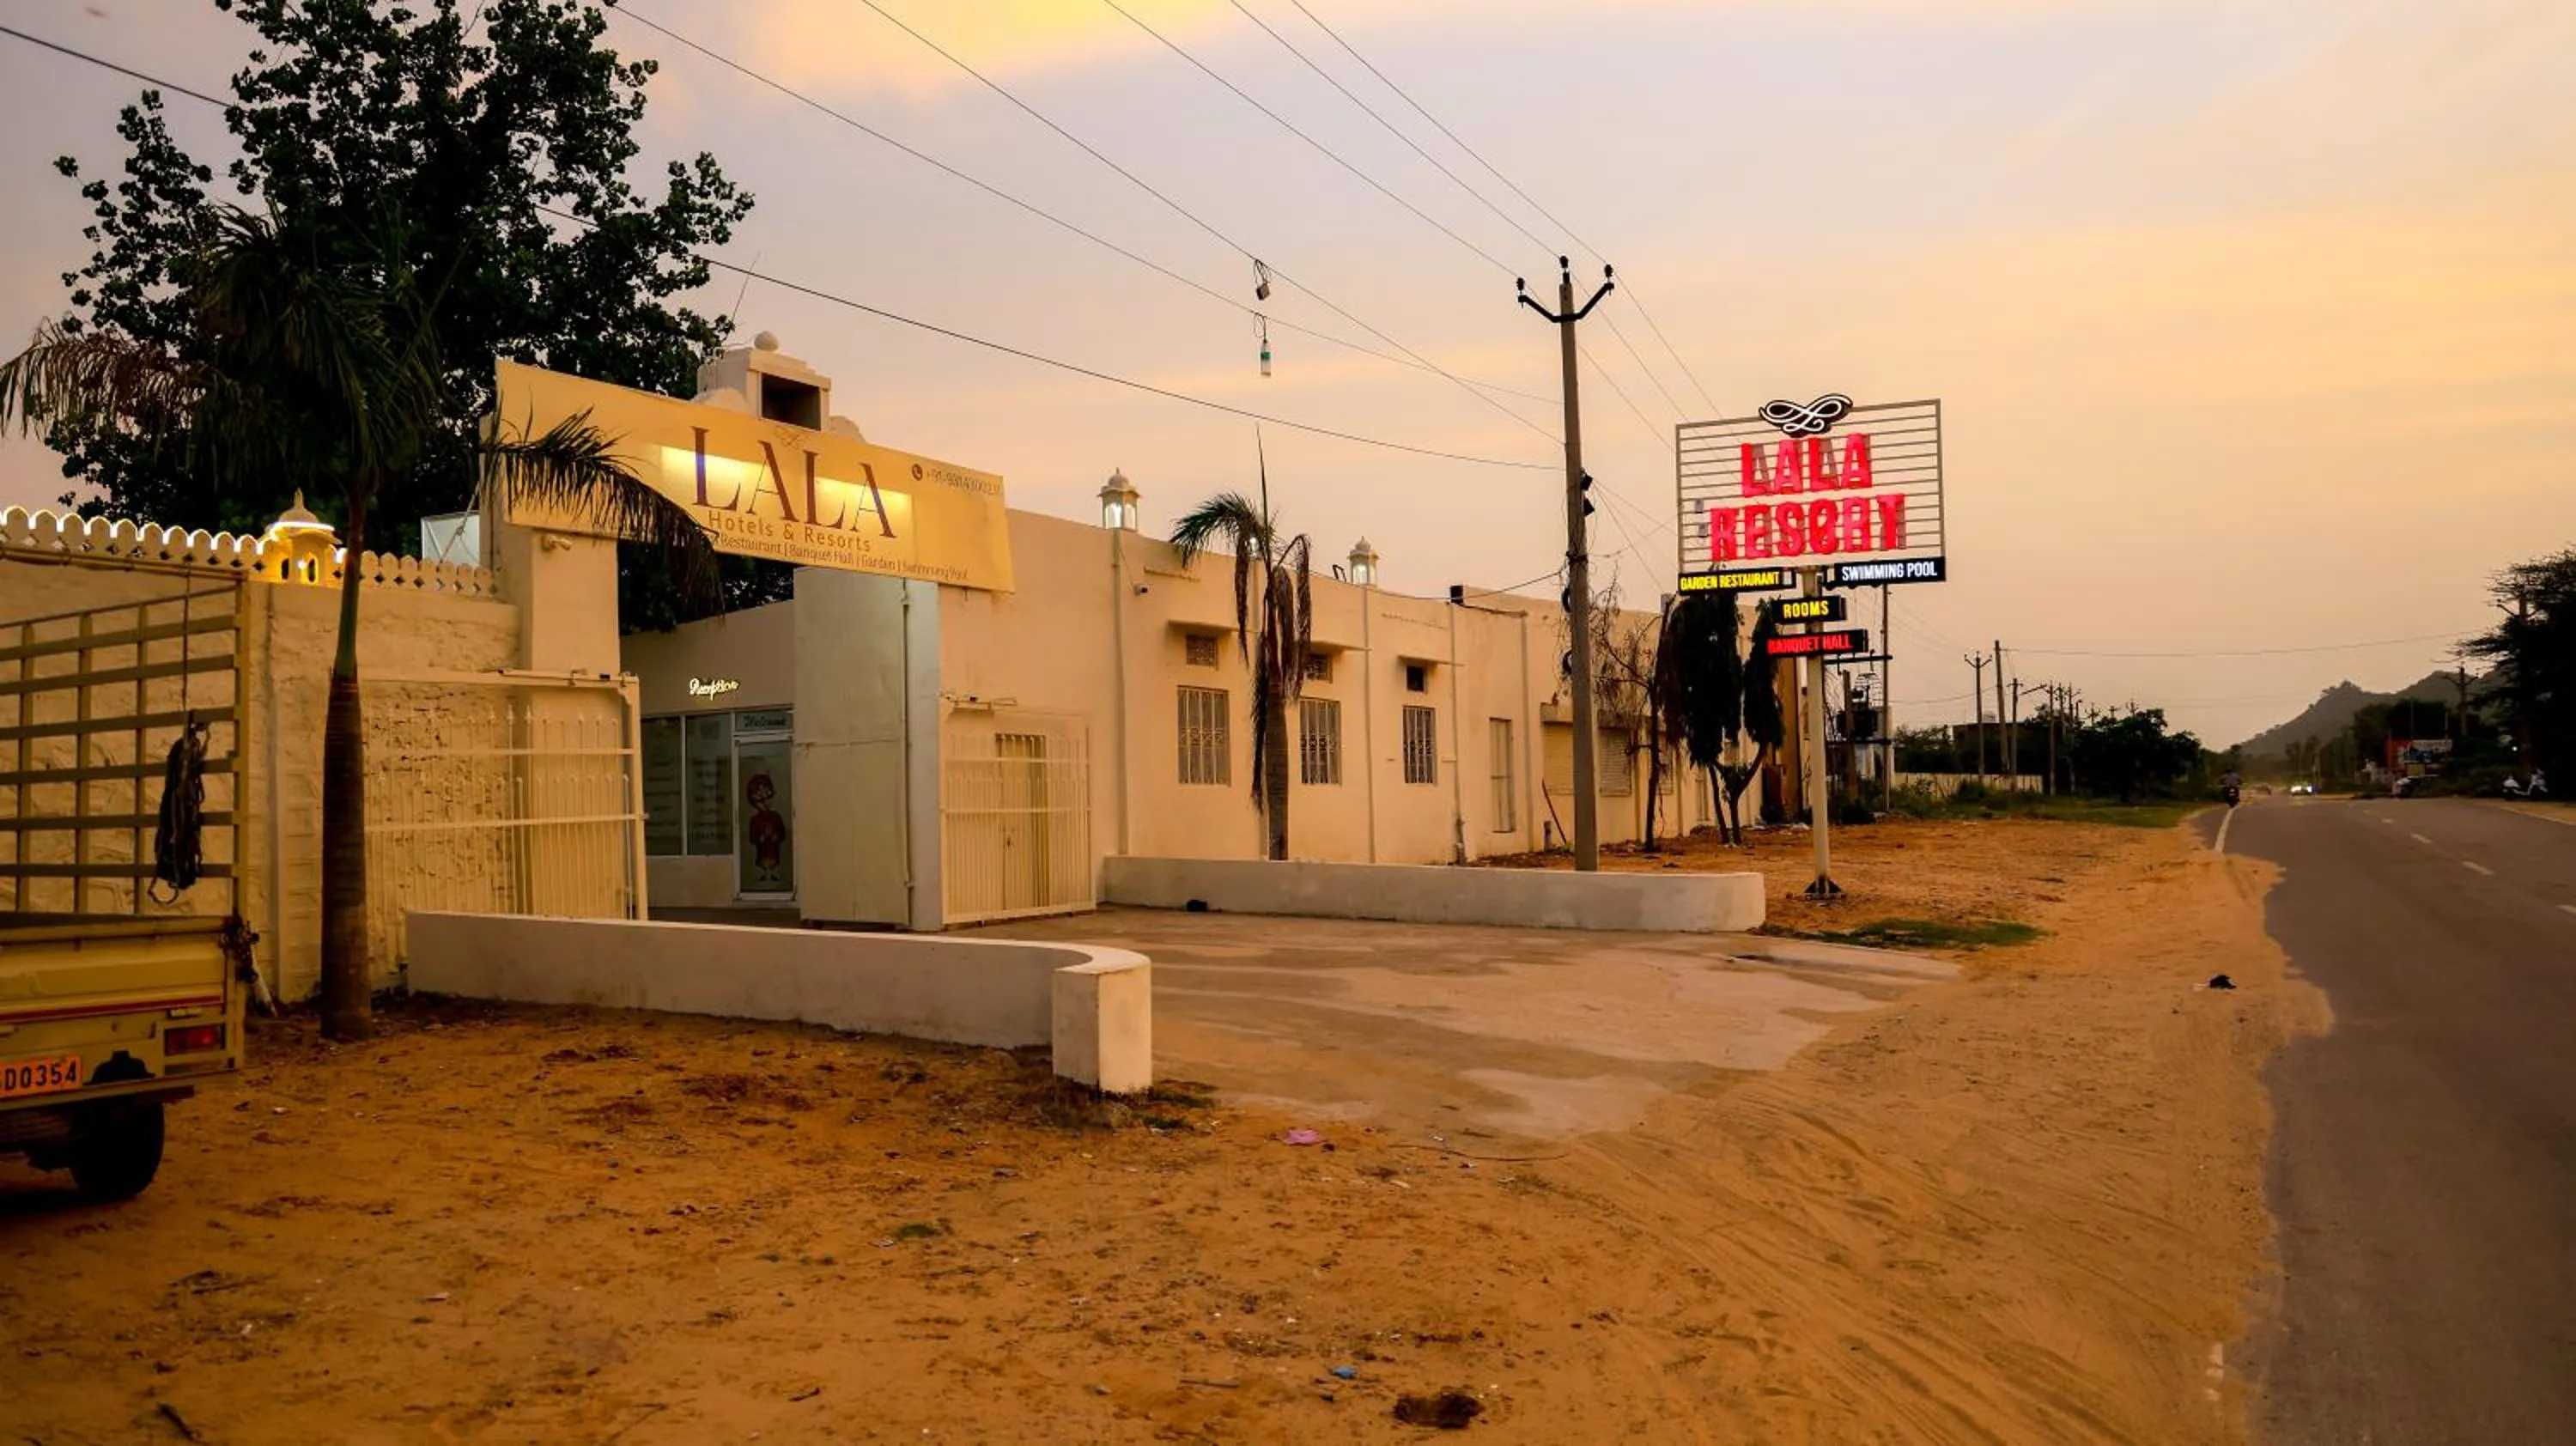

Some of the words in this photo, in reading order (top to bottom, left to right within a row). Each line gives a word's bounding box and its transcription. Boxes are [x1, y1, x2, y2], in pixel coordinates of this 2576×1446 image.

[1741, 433, 1872, 498] LALA
[691, 427, 897, 538] LALA
[708, 510, 773, 537] Hotels
[783, 522, 794, 540] &
[805, 526, 871, 552] Resorts
[1710, 493, 1906, 562] RESORT
[720, 532, 781, 554] Restaurant
[1680, 574, 1717, 591] GARDEN
[1719, 571, 1780, 588] RESTAURANT
[1842, 563, 1904, 581] SWIMMING
[1906, 561, 1937, 578] POOL
[1783, 600, 1829, 618] ROOMS
[1767, 635, 1820, 653] BANQUET
[1823, 633, 1853, 650] HALL
[0, 1060, 76, 1091] D0354
